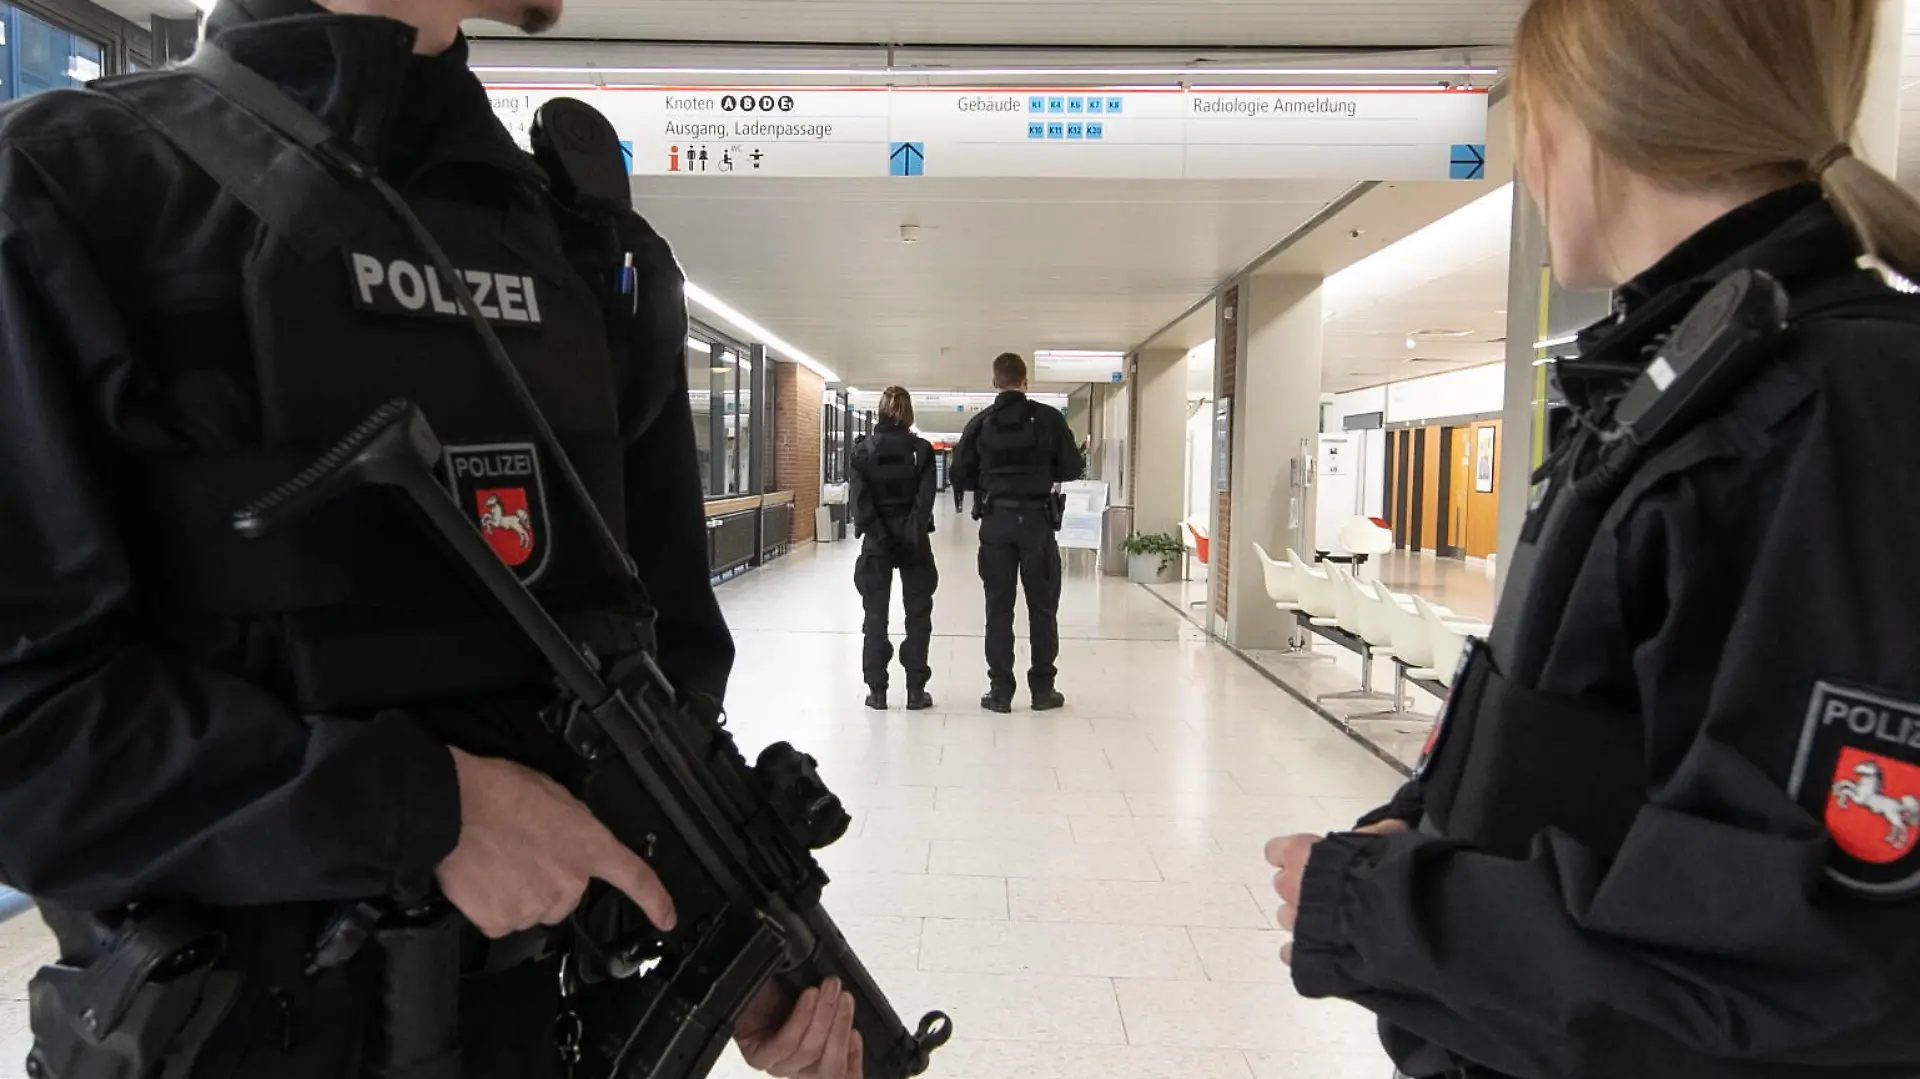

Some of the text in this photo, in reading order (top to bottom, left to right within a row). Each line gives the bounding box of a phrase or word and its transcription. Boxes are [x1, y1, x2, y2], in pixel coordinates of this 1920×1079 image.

[665, 95, 714, 111] Knoten
[957, 96, 1021, 112] Gebäude
[1193, 97, 1357, 117] Radiologie Anmeldung
[664, 119, 833, 140] Ausgang, Ladenpassage
[455, 453, 532, 479] POLIZEI
